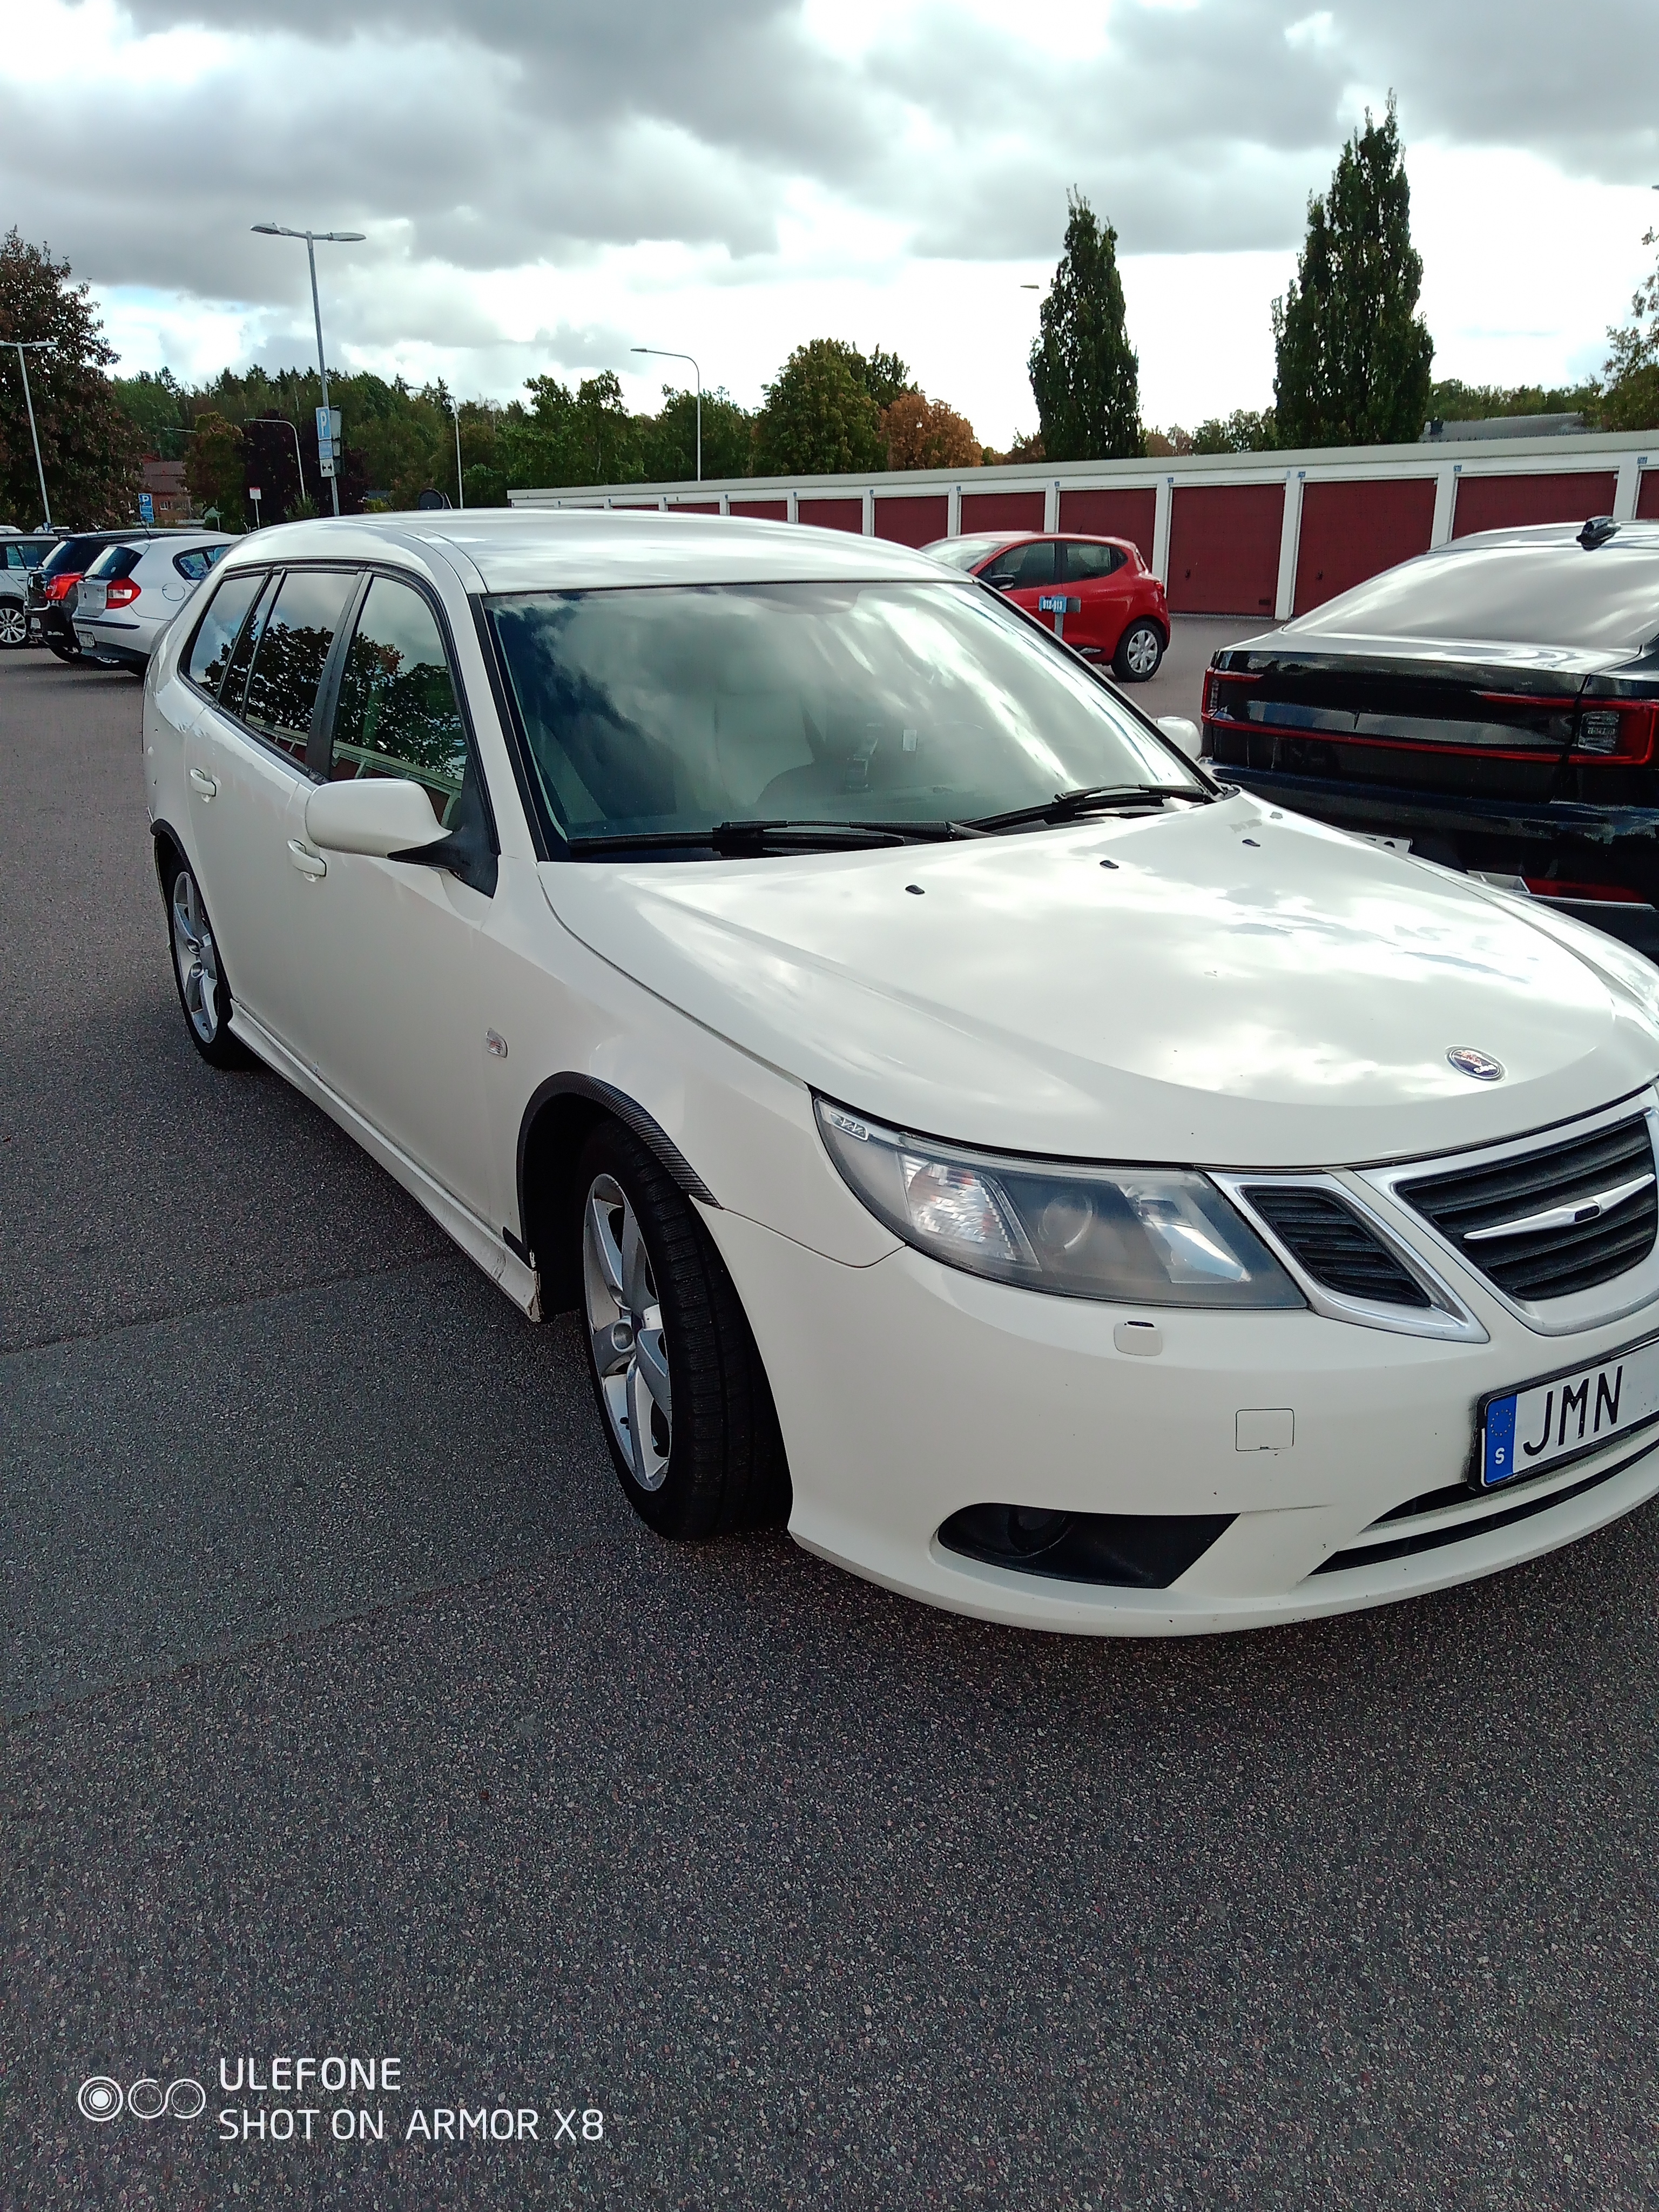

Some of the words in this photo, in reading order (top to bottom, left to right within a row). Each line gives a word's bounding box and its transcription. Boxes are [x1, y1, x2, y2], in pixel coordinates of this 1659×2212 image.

[320, 411, 327, 436] P
[141, 495, 150, 505] P
[1522, 1365, 1623, 1456] JMN
[1495, 1447, 1505, 1464] S
